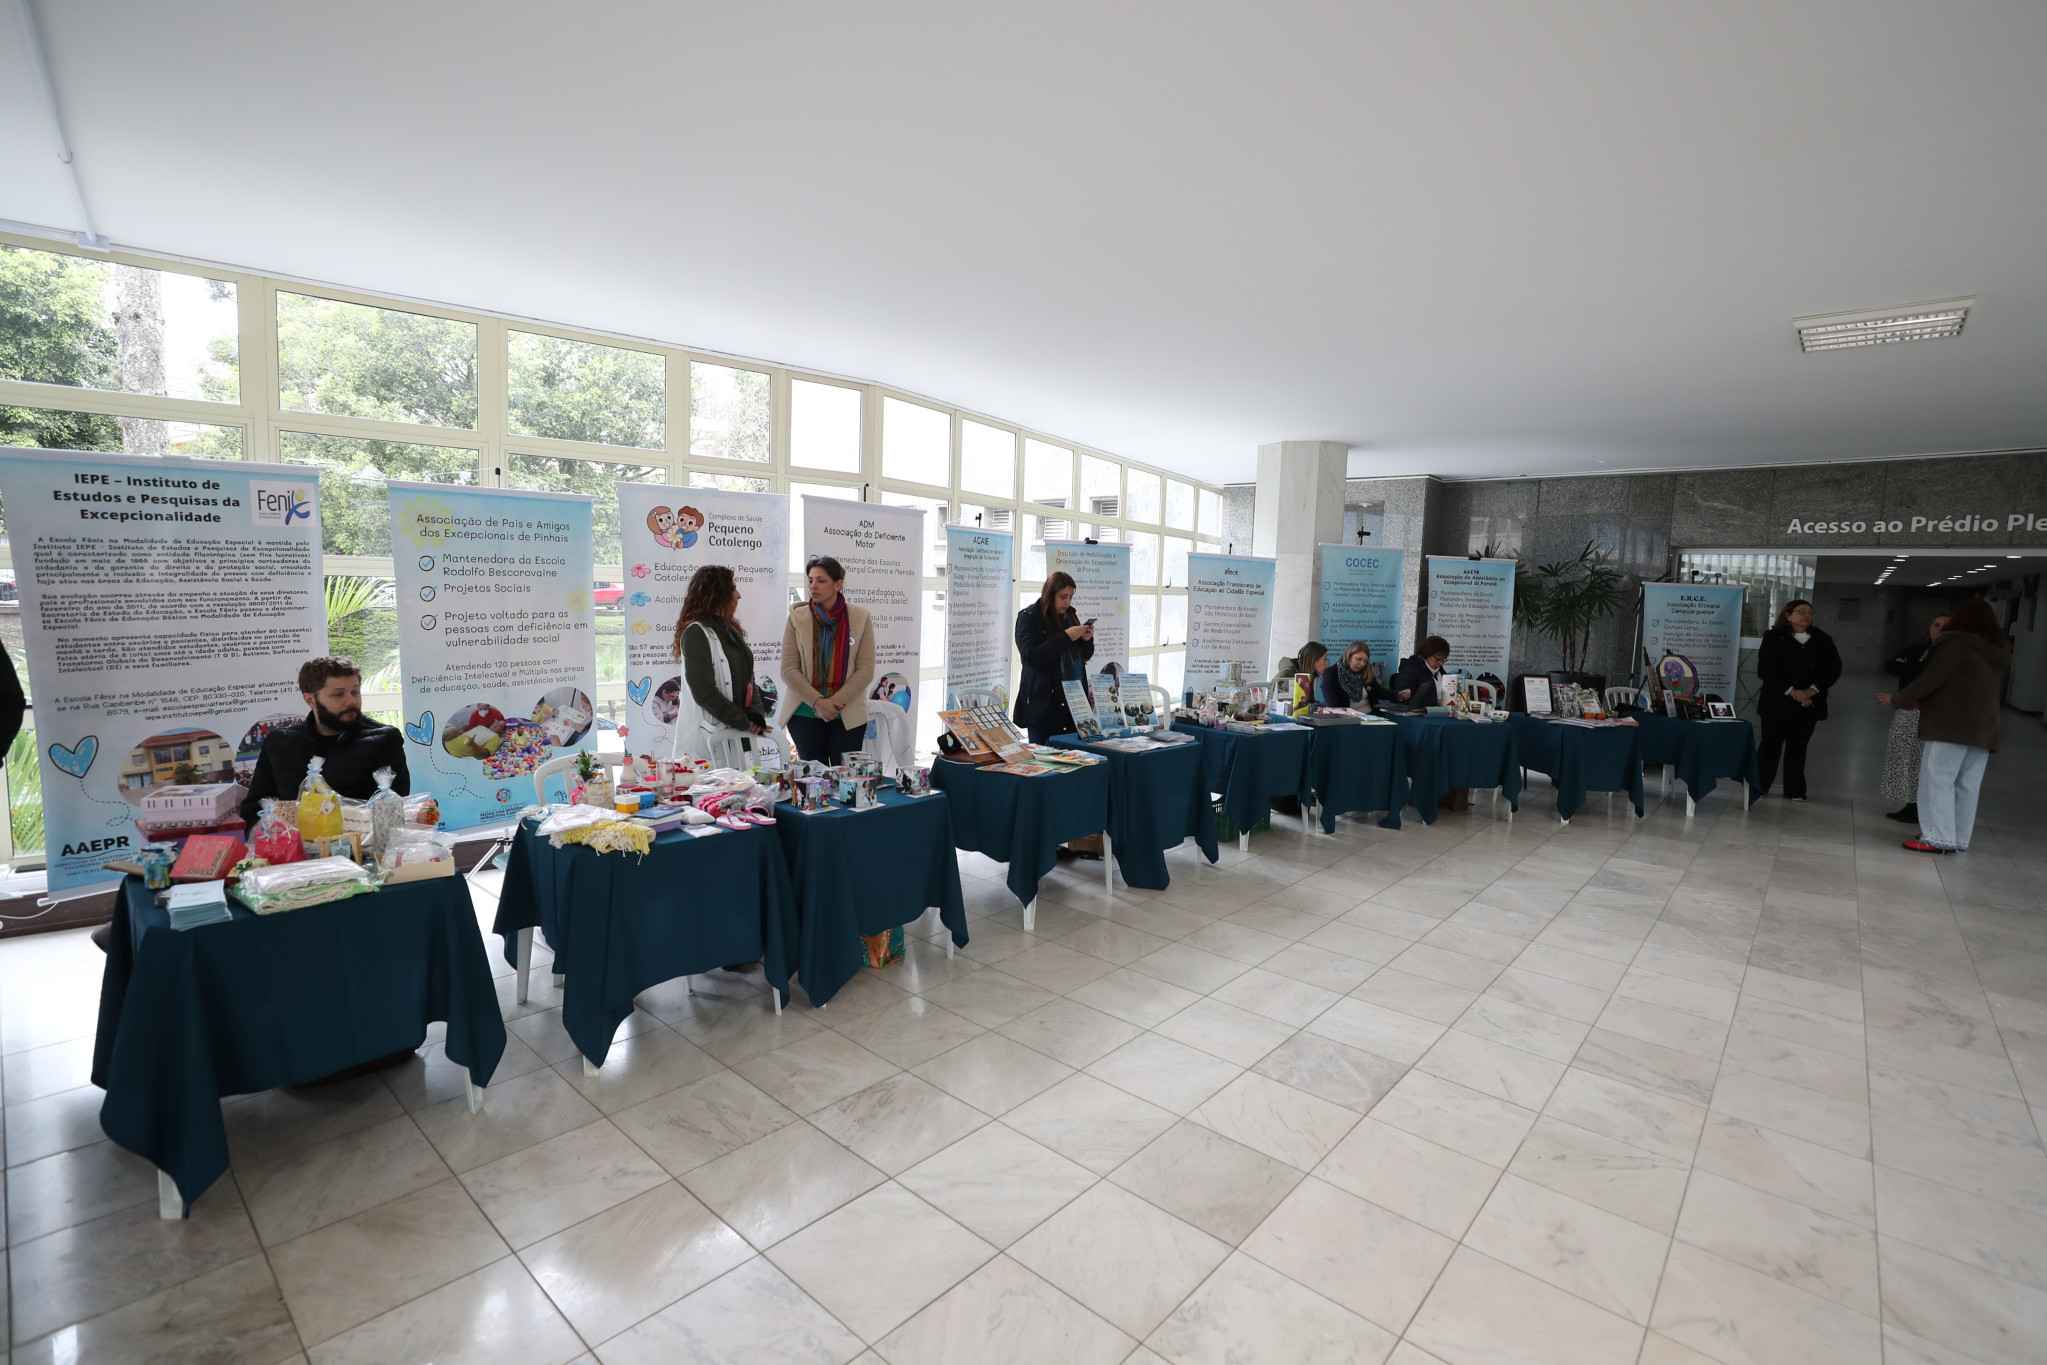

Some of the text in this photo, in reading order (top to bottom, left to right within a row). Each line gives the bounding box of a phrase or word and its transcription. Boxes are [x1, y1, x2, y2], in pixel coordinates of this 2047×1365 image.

[74, 473, 110, 485] IEPE
[127, 477, 198, 489] Instituto
[202, 479, 220, 490] de
[53, 490, 240, 507] Estudos e Pesquisas da
[80, 509, 222, 523] Excepcionalidade
[709, 513, 736, 522] Complexo
[416, 514, 482, 526] Associação
[486, 517, 498, 526] de
[503, 519, 523, 528] Pais
[537, 521, 570, 532] Amigos
[709, 522, 753, 535] Pequeno
[1787, 519, 1867, 534] Acesso
[1873, 521, 1903, 533] ao
[1910, 514, 1998, 533] Prédio
[420, 528, 568, 542] dos Excepcionais de Pinhais
[824, 527, 861, 538] Associação
[875, 532, 905, 541] Deficiente
[709, 536, 762, 550] Cotolengo
[856, 540, 875, 548] Motor
[973, 537, 989, 545] ACAE
[443, 554, 565, 565] Mantenedora da Escola
[1346, 558, 1379, 568] COCEC
[444, 567, 557, 577] Rodolfo Bescorovaine
[655, 563, 773, 574] Educação Pequeno
[444, 584, 530, 594] Projetos Sociais
[854, 596, 889, 604] assistência
[445, 612, 486, 622] Projeto
[490, 611, 528, 620] voltado
[532, 611, 555, 620] para
[445, 625, 489, 635] pessoas
[493, 624, 514, 632] com
[518, 621, 570, 631] deficiência
[446, 634, 560, 647] vulnerabilidade social
[446, 661, 492, 671] Atendendo
[510, 659, 540, 669] pessoas
[411, 672, 462, 683] Deficiência
[464, 670, 509, 680] Intelectual
[519, 667, 547, 676] Múltipla
[132, 690, 175, 698] Modalidade
[228, 683, 255, 691] Especial
[420, 685, 432, 693] de
[434, 683, 479, 692] educação,
[483, 680, 509, 688] saúde,
[512, 677, 553, 686] assistência
[103, 700, 145, 708] Capiberibe
[61, 836, 130, 856] AAEPR
